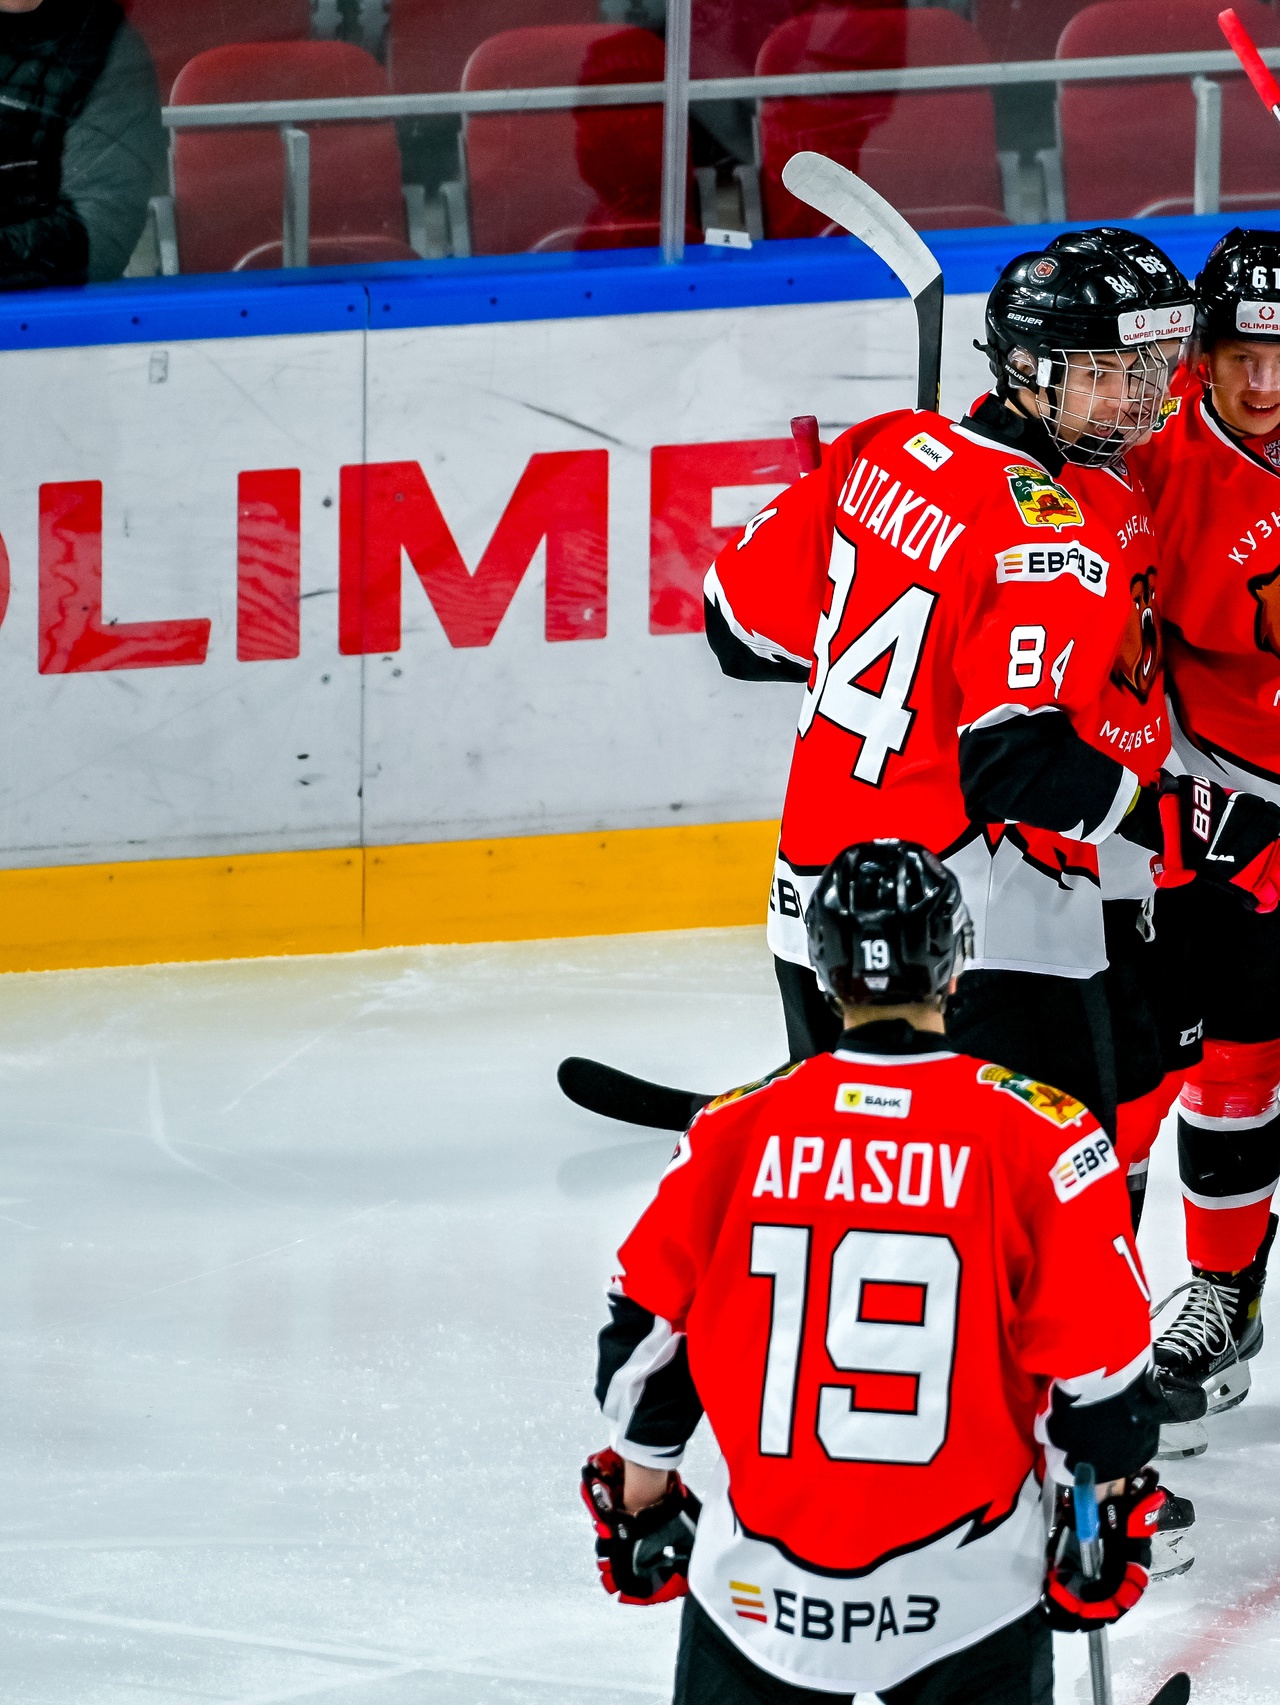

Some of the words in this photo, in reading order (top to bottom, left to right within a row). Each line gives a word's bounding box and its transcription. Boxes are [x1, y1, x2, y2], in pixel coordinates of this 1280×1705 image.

[1136, 255, 1167, 275] 68
[1104, 275, 1137, 294] 84
[1252, 266, 1280, 289] 61
[1007, 312, 1043, 326] BAUER
[1155, 325, 1192, 336] OLIMPBET
[919, 444, 943, 463] БАНК
[1007, 625, 1075, 699] 84
[860, 939, 890, 970] 19
[864, 1095, 902, 1108] БАНК
[752, 1135, 971, 1208] APASOV
[750, 1223, 962, 1465] 19
[773, 1588, 941, 1644] ЕВРАЗ
